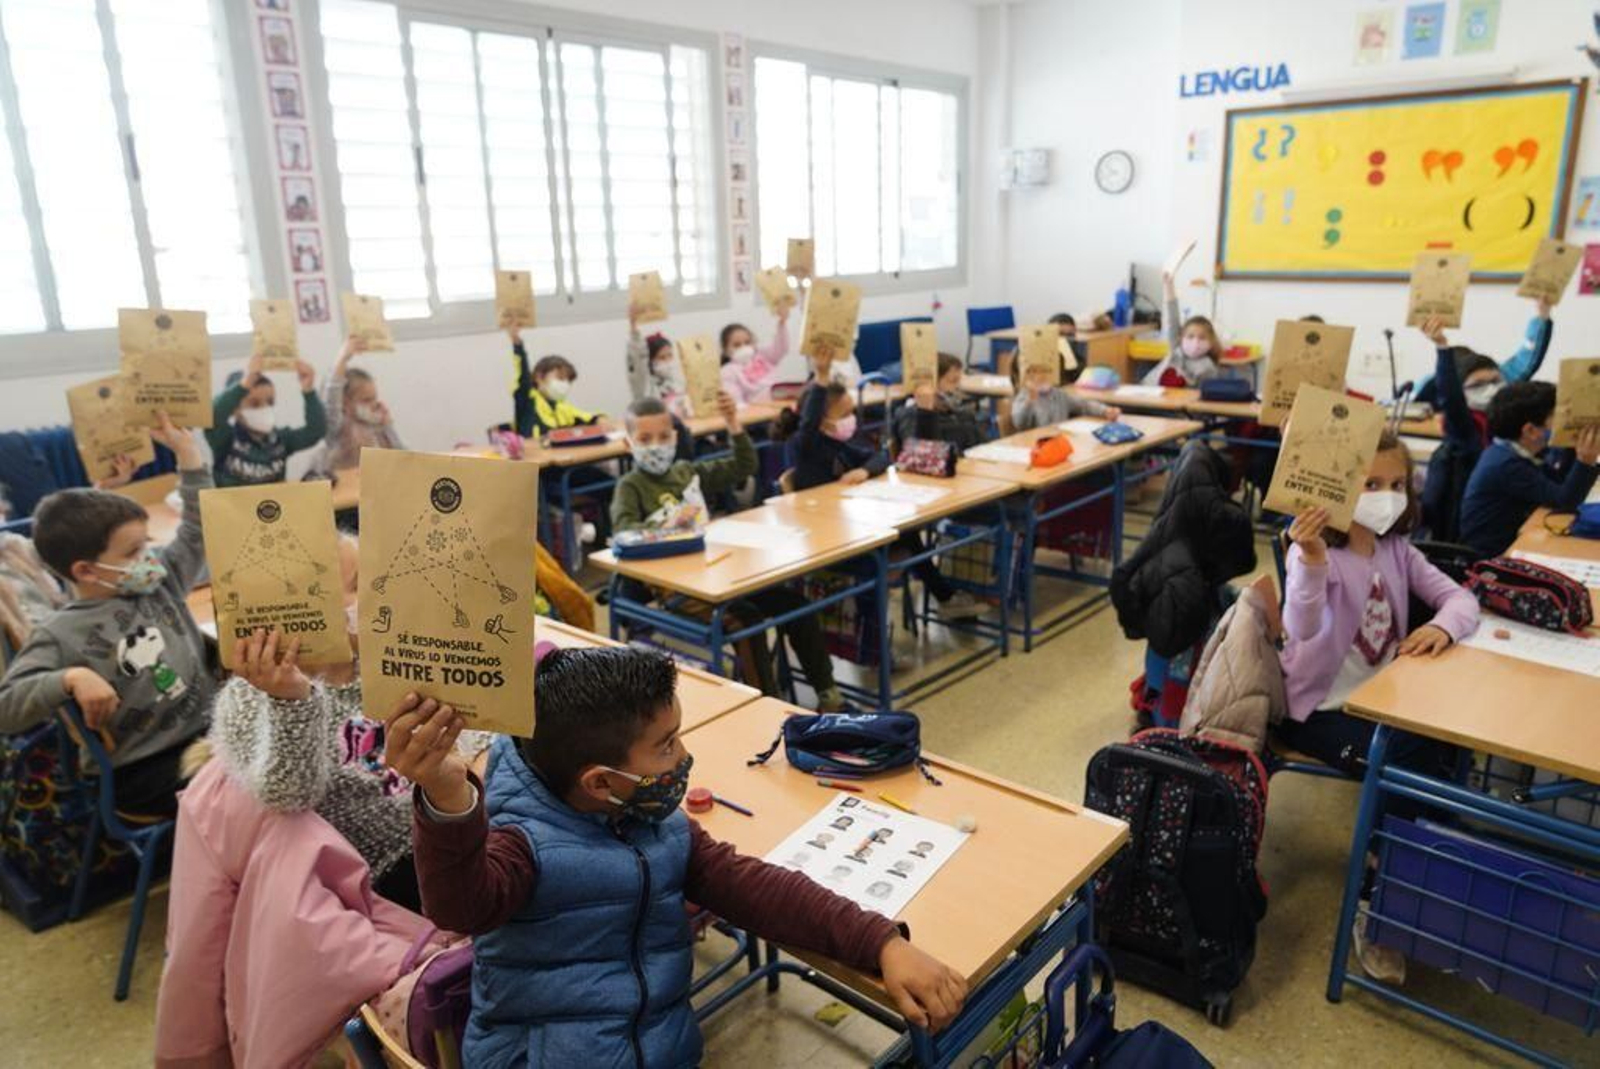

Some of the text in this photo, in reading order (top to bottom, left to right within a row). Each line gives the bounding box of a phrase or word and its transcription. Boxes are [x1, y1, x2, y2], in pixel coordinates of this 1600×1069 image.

[1179, 62, 1290, 98] LENGUA
[282, 619, 327, 634] TODOS
[411, 634, 485, 652] RESPONSABLE
[384, 646, 502, 667] AL VIRUS LO VENCEMOS
[381, 659, 505, 688] ENTRE TODOS
